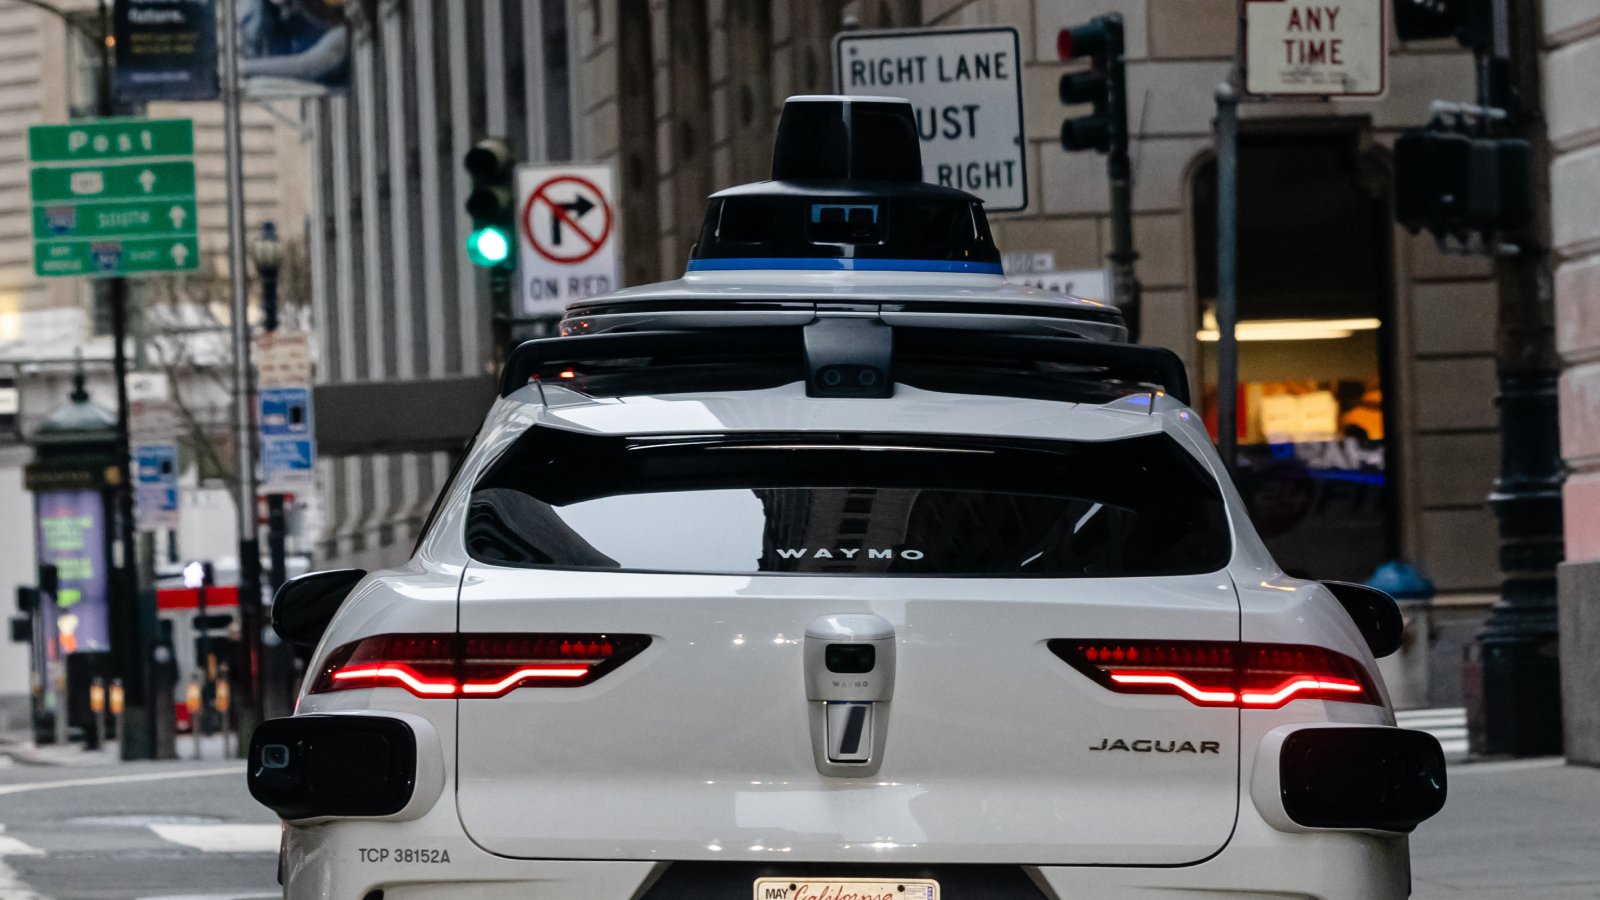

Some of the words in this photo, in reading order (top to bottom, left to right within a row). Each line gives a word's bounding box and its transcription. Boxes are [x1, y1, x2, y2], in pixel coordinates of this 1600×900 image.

[1287, 6, 1341, 32] ANY
[1283, 39, 1344, 64] TIME
[850, 56, 926, 86] RIGHT
[938, 52, 1008, 82] LANE
[916, 105, 980, 141] UST
[68, 130, 153, 153] Post
[937, 160, 1016, 190] RIGHT
[529, 277, 558, 300] ON
[568, 274, 611, 296] RED
[776, 548, 924, 561] WAYMO
[1089, 738, 1220, 753] JAGUAR
[358, 848, 389, 862] TCP
[394, 848, 450, 863] 38152A
[765, 888, 788, 899] MAY
